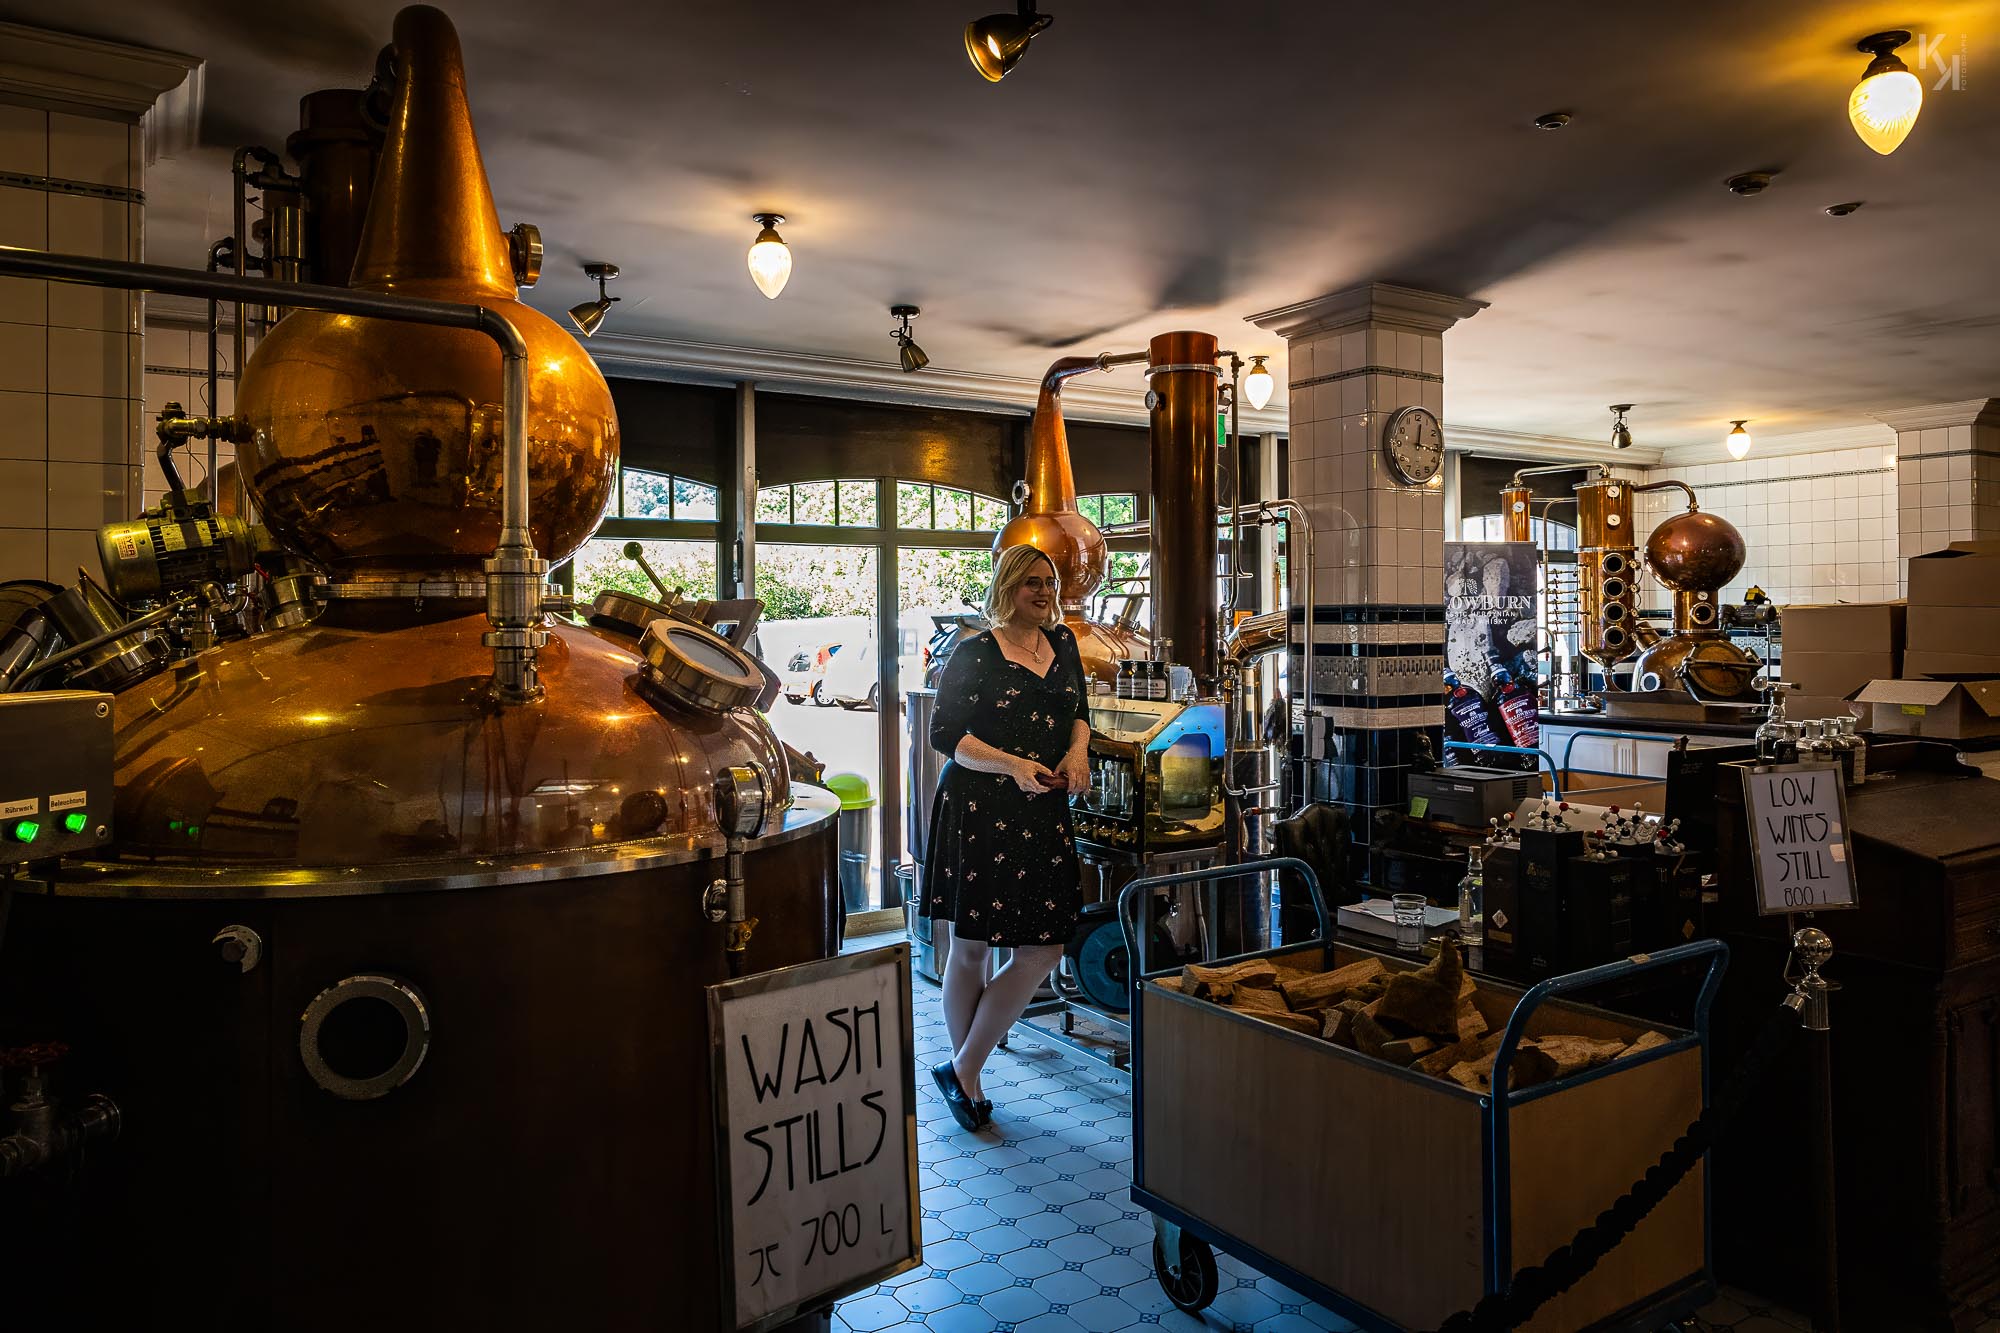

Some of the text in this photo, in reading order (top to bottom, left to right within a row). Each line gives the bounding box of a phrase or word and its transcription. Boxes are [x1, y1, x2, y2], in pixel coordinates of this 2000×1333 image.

[1406, 417, 1411, 425] 11
[1406, 465, 1411, 473] 7
[1415, 469, 1421, 477] 6
[1447, 595, 1532, 610] OWBURN
[50, 797, 85, 807] Beleuchtung
[1769, 777, 1815, 807] LOW
[5, 804, 34, 814] Rührwerk
[1766, 813, 1828, 844] WINES
[1776, 850, 1831, 881] STILL
[1784, 886, 1814, 907] 800
[742, 1001, 882, 1104] WASH
[744, 1090, 887, 1206] STILLS
[801, 1203, 860, 1266] 700
[880, 1203, 893, 1235] L
